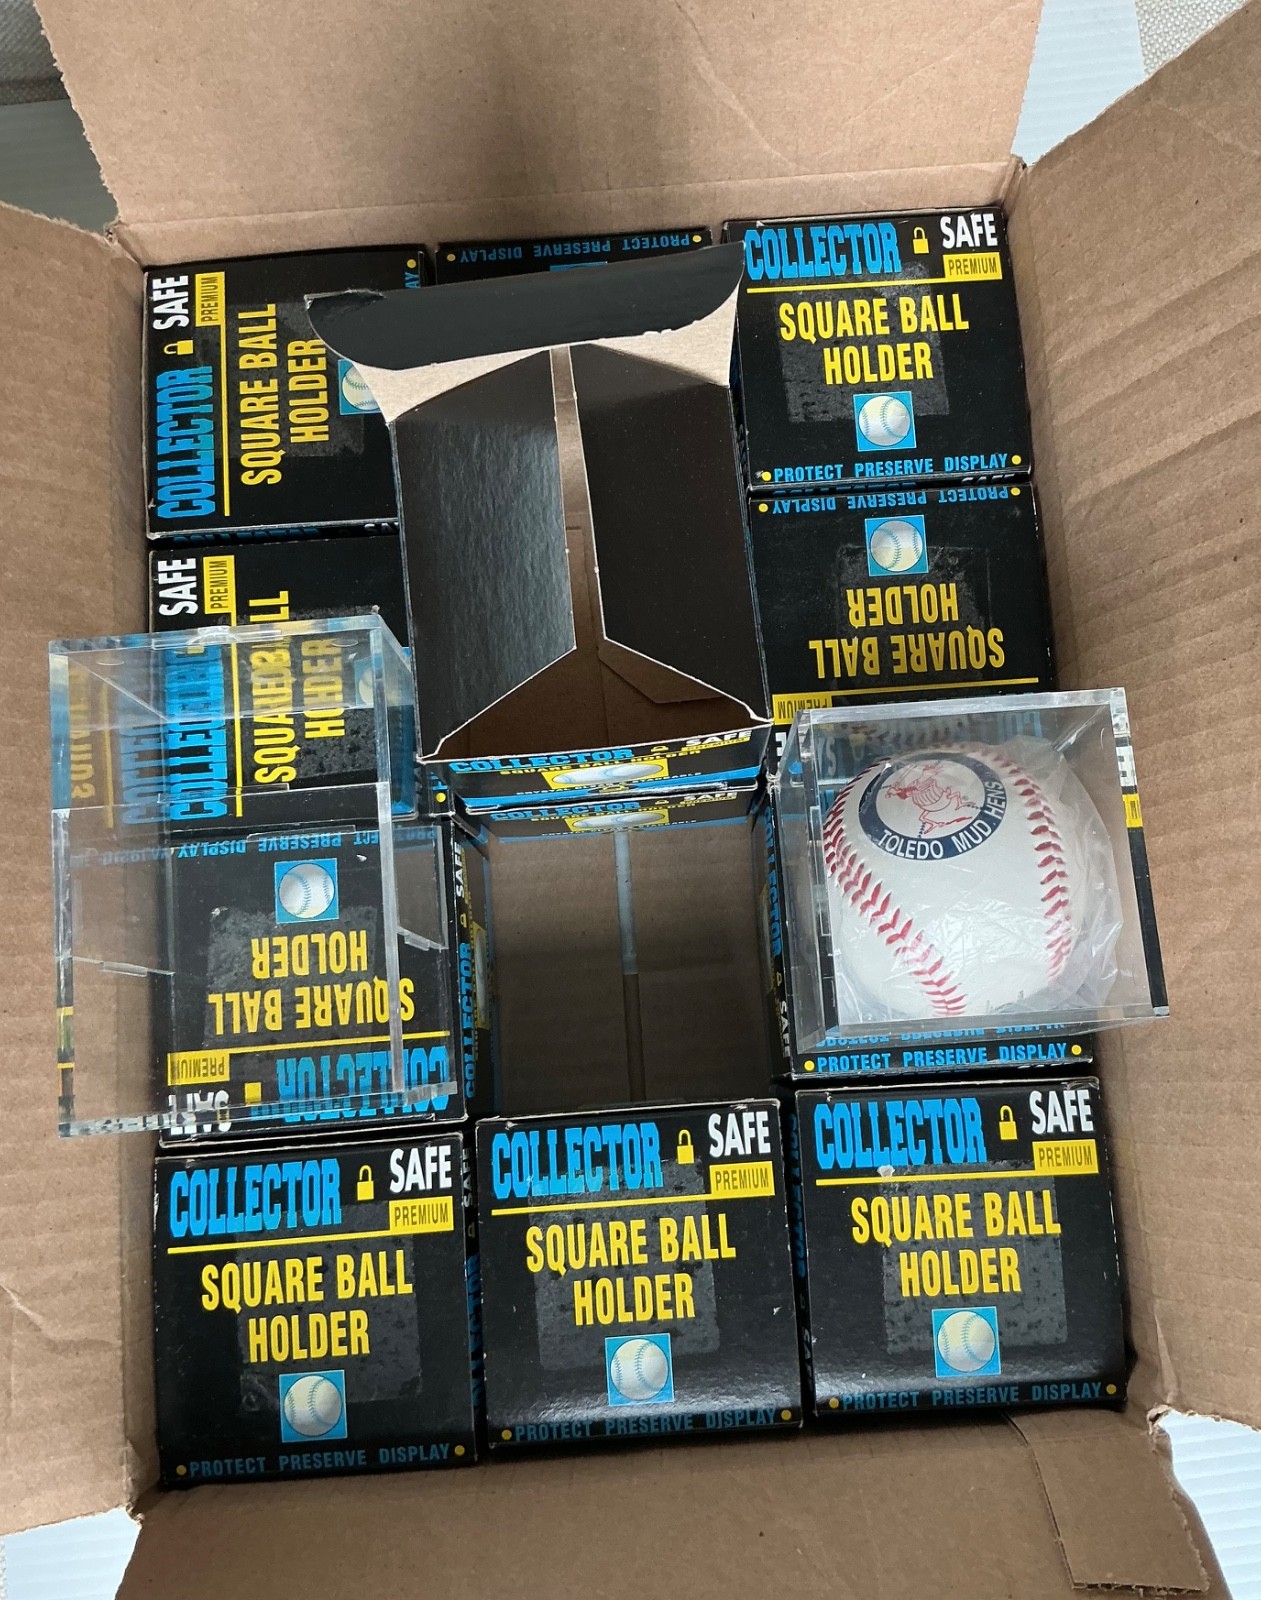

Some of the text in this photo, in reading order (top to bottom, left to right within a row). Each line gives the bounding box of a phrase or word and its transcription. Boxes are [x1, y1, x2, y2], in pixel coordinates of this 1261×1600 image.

[459, 234, 690, 264] PROTECT PRESERVE DISPLAY
[744, 213, 998, 281] COLLECTOR SAFE
[948, 257, 997, 276] PREMIUM
[201, 276, 219, 322] PREMIUM
[779, 293, 969, 344] SQUARE BALL
[823, 342, 933, 385] HOLDER
[152, 275, 215, 519] COLLECTOR SAFE
[238, 303, 286, 486] SQUARE BALL
[287, 339, 330, 443] HOLDER
[774, 453, 1009, 483] PROTECT PRESERVE DISPLAY
[772, 486, 1009, 514] PROTECT PRESERVE DISPLAY
[157, 557, 198, 616] SAFE
[210, 560, 228, 610] PREMIUM
[846, 582, 959, 628] HOLDER
[248, 590, 292, 672] BLL
[809, 625, 1005, 679] SQUARE BALL
[449, 730, 753, 772] COLLECTOR SAFE
[490, 801, 640, 821] COLLECTOR
[878, 780, 1006, 860] TOLEDO MUD HENS
[178, 838, 246, 859] DISPLAY
[258, 833, 341, 852] PRESERVE
[454, 841, 465, 897] SAFE
[251, 930, 368, 979] HOLDER
[208, 975, 415, 1036] SQUARE BALL
[459, 941, 475, 1099] COLLECTOR
[817, 1042, 1067, 1073] PROTECT PRESERVE DISPLAY
[813, 1089, 1094, 1170] COLLECTOR SAFE
[492, 1110, 771, 1200] COLLECTOR SAFE
[715, 1167, 770, 1190] PREMIUM
[1039, 1145, 1093, 1168] PREMIUM
[170, 1144, 453, 1238] COLLECTOR SAFE
[394, 1203, 449, 1227] PREMIUM
[850, 1189, 1062, 1247] SQUARE BALL
[526, 1213, 736, 1277] SQUARE BALL
[201, 1249, 413, 1314] SQUARE BALL
[899, 1247, 1021, 1297] HOLDER
[573, 1273, 696, 1326] HOLDER
[248, 1309, 370, 1363] HOLDER
[842, 1381, 1102, 1411] PROTECT PRESERVE DISPLAY
[515, 1406, 777, 1442] PROTECT PRESERVE DISPLAY
[190, 1443, 450, 1478] PROTECT PRESERVE DISPLAY
